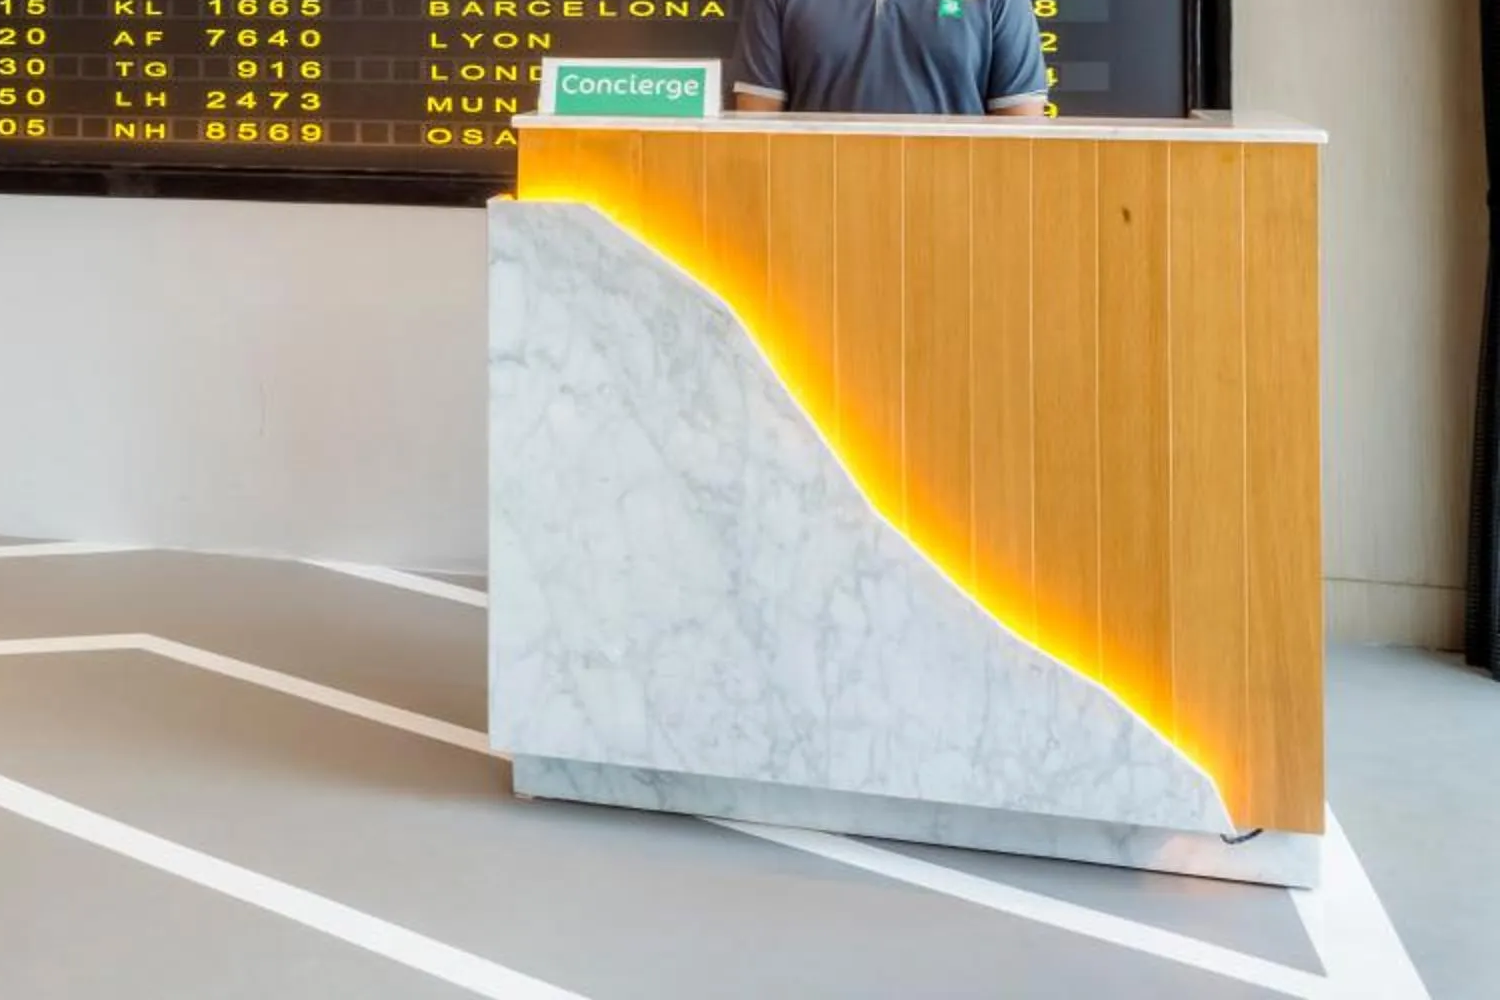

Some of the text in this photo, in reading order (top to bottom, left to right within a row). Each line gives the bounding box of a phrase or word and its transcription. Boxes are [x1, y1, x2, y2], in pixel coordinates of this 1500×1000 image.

[114, 0, 162, 16] KL
[428, 0, 725, 18] BARCELONA
[113, 30, 164, 47] AF
[205, 28, 322, 49] 7640
[430, 31, 551, 50] LYON
[1041, 31, 1058, 53] 2
[115, 61, 168, 78] TG
[237, 59, 322, 80] 916
[561, 74, 699, 100] Concierge
[115, 91, 167, 108] LH
[205, 90, 322, 111] 2473
[426, 95, 518, 114] MUN
[114, 122, 166, 140] NH
[205, 121, 324, 145] 8569
[426, 128, 518, 146] OSA
